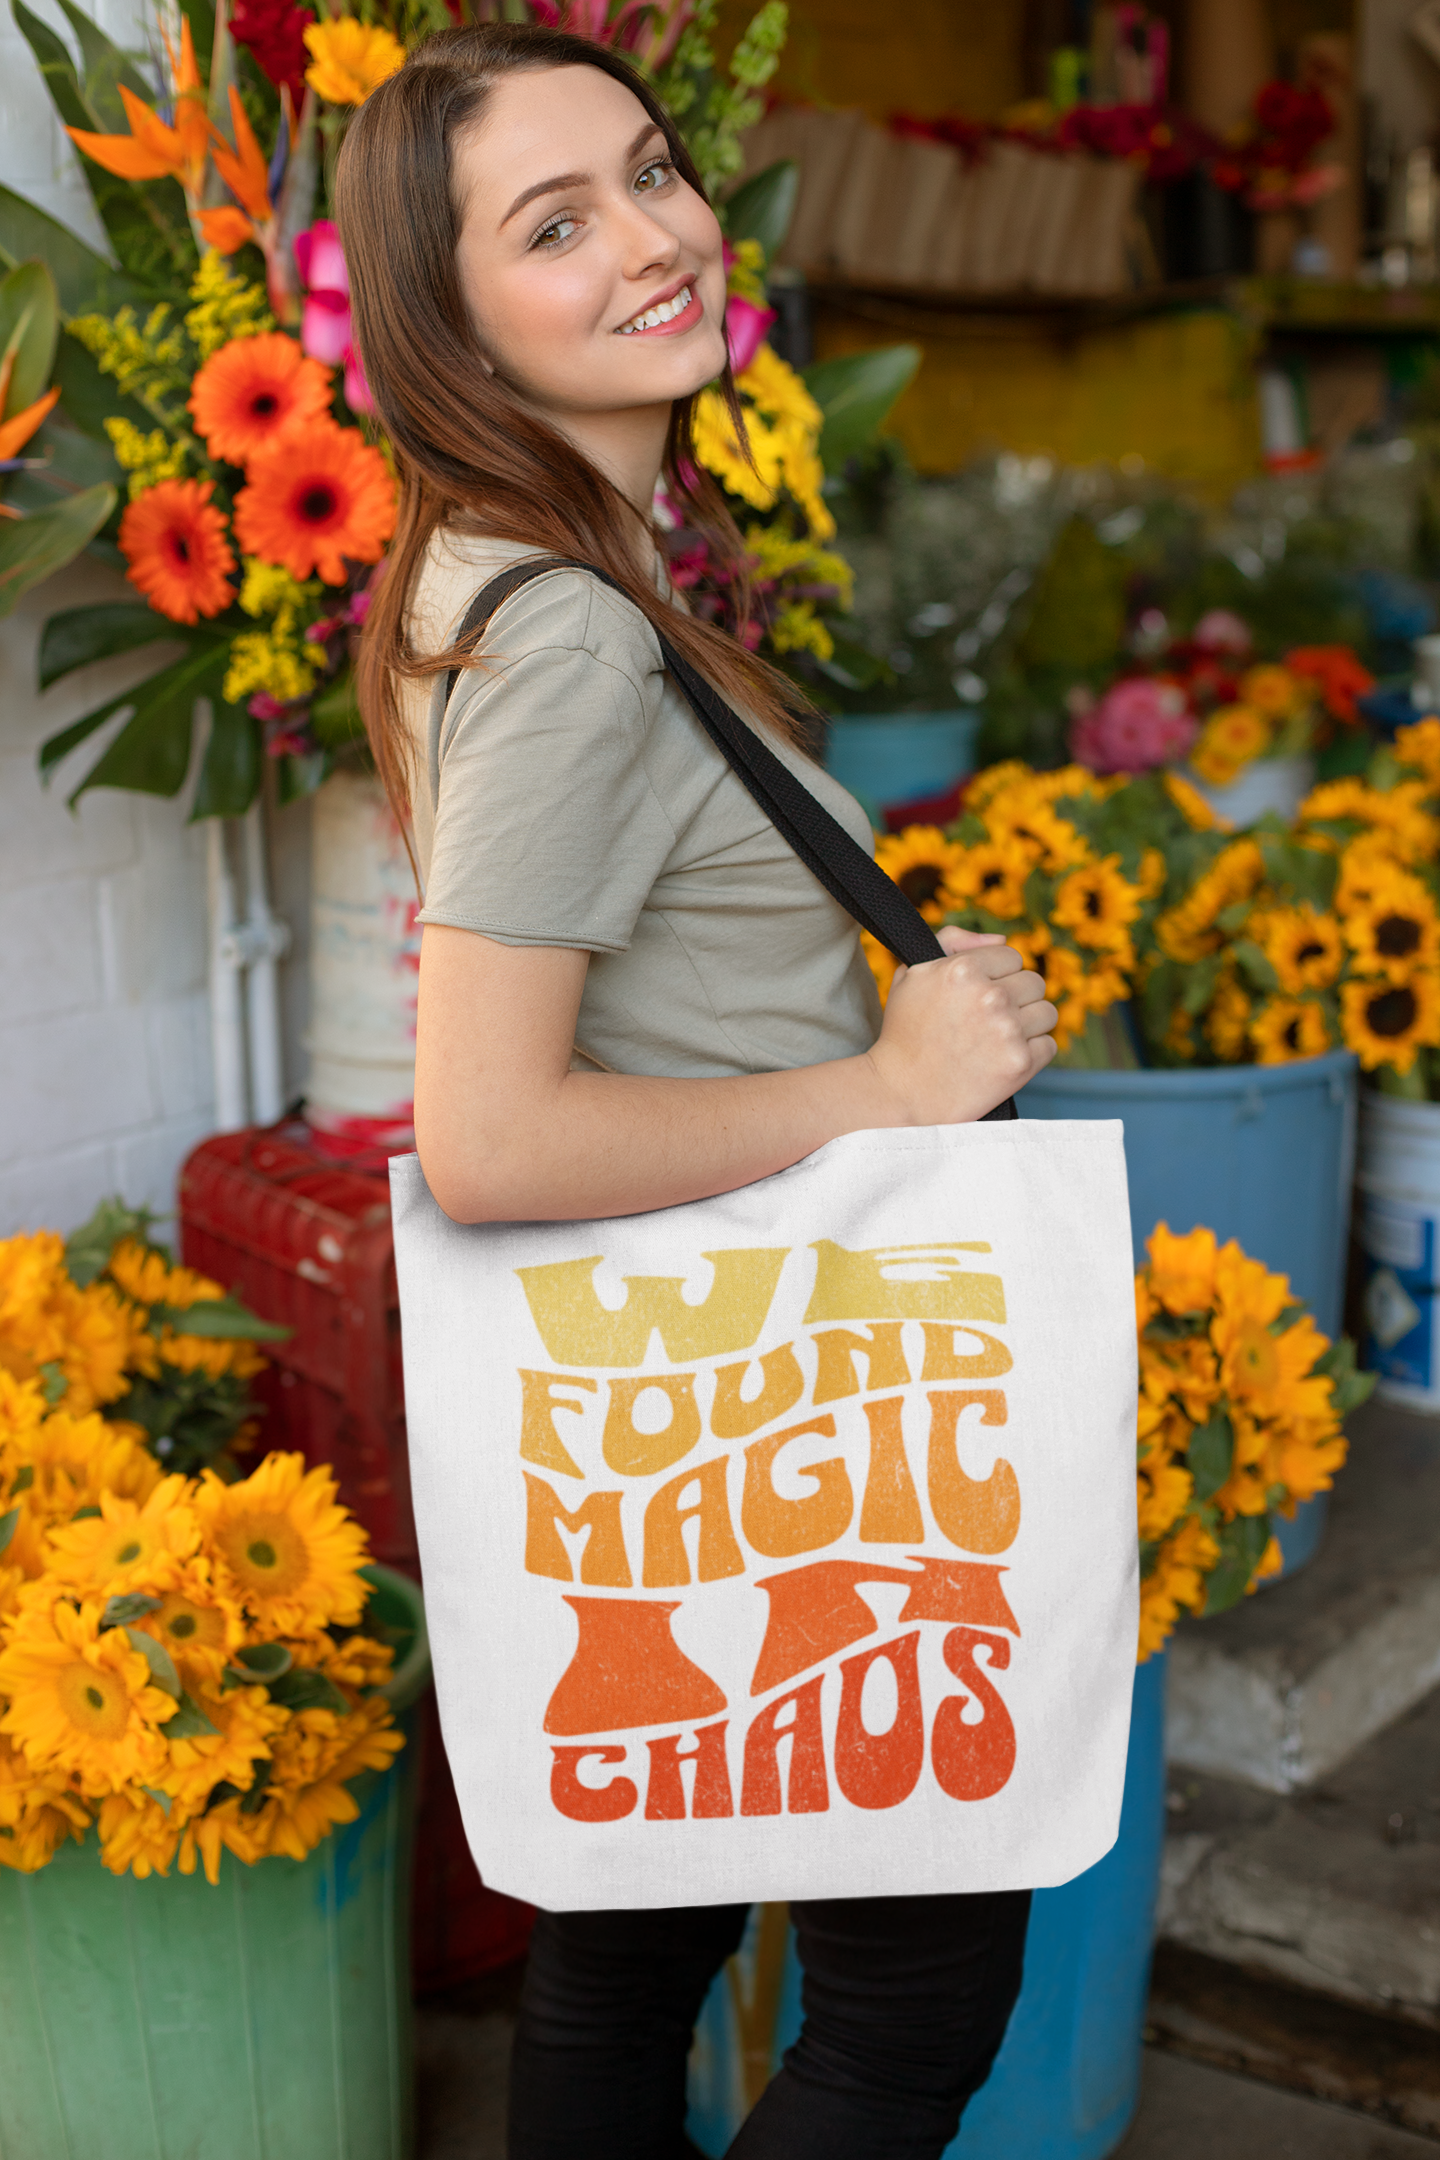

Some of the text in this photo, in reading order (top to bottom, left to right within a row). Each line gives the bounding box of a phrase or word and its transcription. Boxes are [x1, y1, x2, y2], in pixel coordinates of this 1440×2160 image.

[513, 1238, 1007, 1368] WE
[517, 1321, 1014, 1480] FOUND
[521, 1389, 1021, 1589] MAGIC
[542, 1555, 1022, 1738] IN
[549, 1625, 1017, 1823] CHAOS
